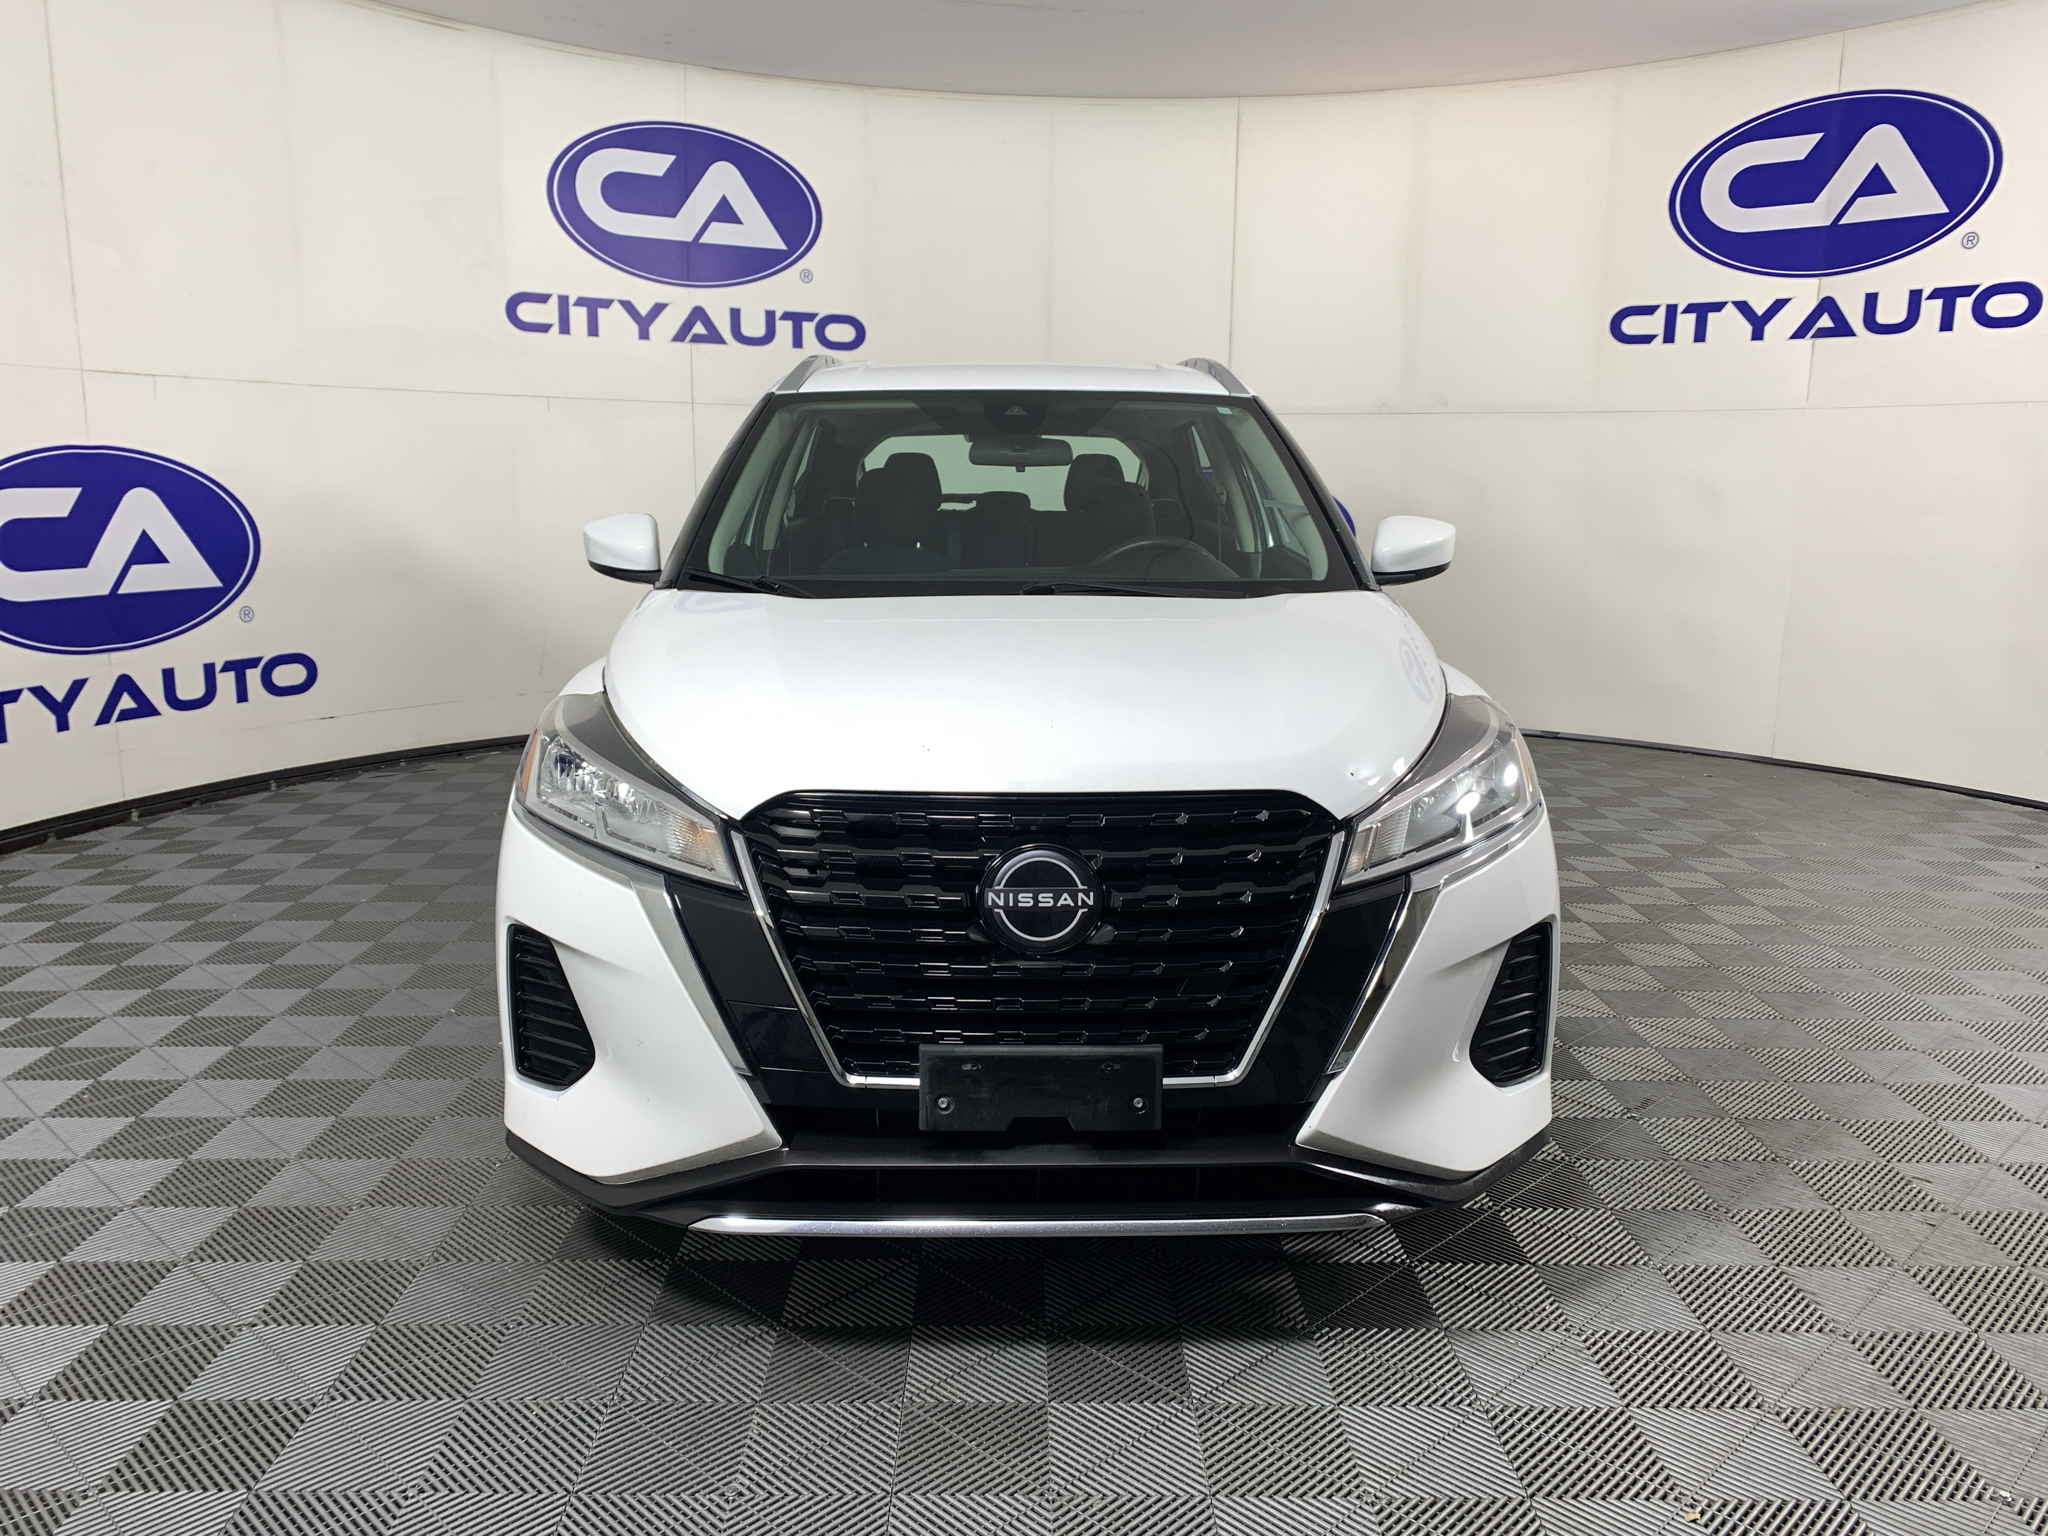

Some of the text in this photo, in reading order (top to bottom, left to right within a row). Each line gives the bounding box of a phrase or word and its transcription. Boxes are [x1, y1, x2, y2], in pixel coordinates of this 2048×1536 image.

[575, 147, 788, 250] CA
[1701, 124, 1950, 233] CA
[987, 890, 1094, 907] NISSAN
